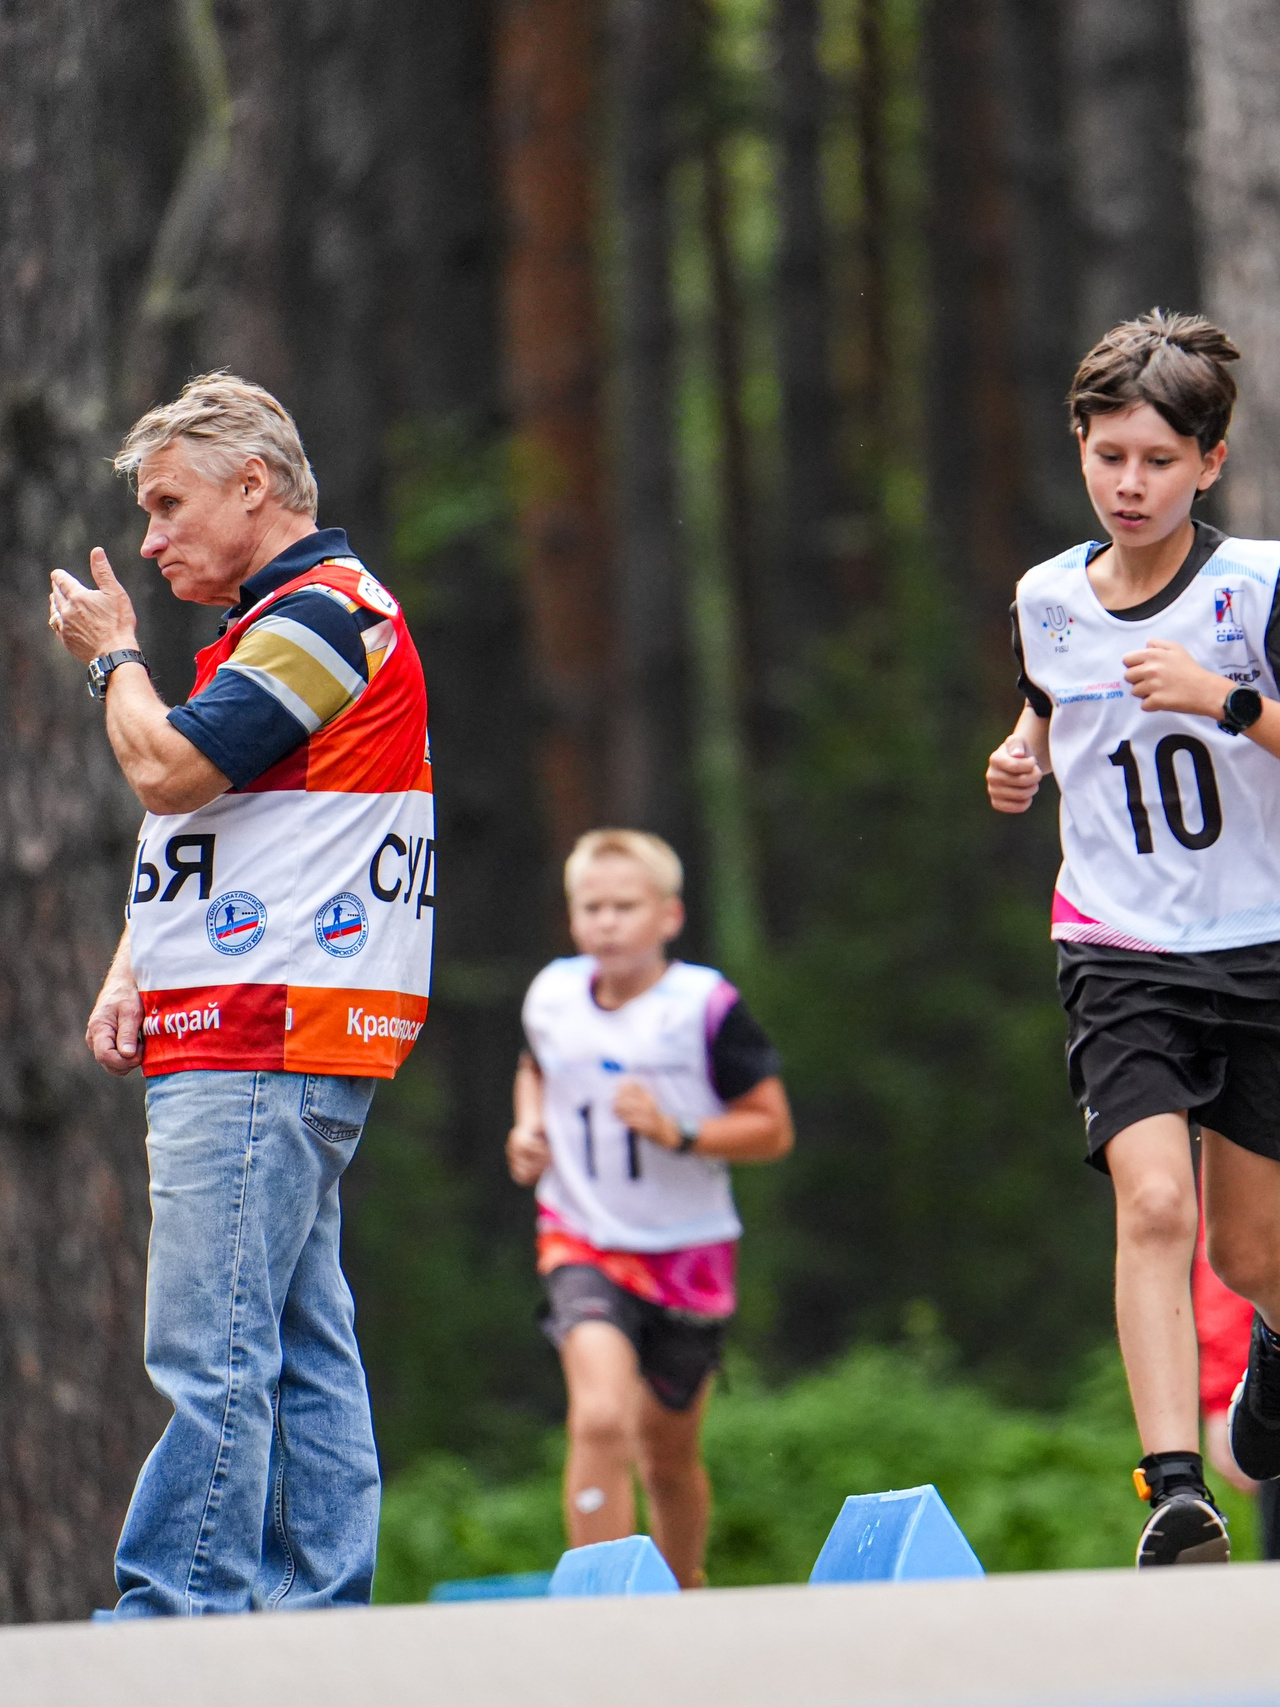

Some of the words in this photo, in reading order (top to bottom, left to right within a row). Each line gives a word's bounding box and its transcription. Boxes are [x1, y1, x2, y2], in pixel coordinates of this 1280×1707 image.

[1055, 645, 1070, 653] FISU
[1108, 733, 1223, 854] 10
[130, 833, 216, 911] ЬЯ
[208, 900, 221, 920] СОЮЗ
[221, 892, 266, 919] БИАТЛОНИСТОВ
[209, 928, 252, 954] КРАСНОЯРСКОГО
[250, 926, 263, 944] КРАЯ
[316, 927, 359, 956] КРАСНОЯРСКОГО
[357, 930, 367, 947] КРАЯ
[164, 1002, 221, 1040] край
